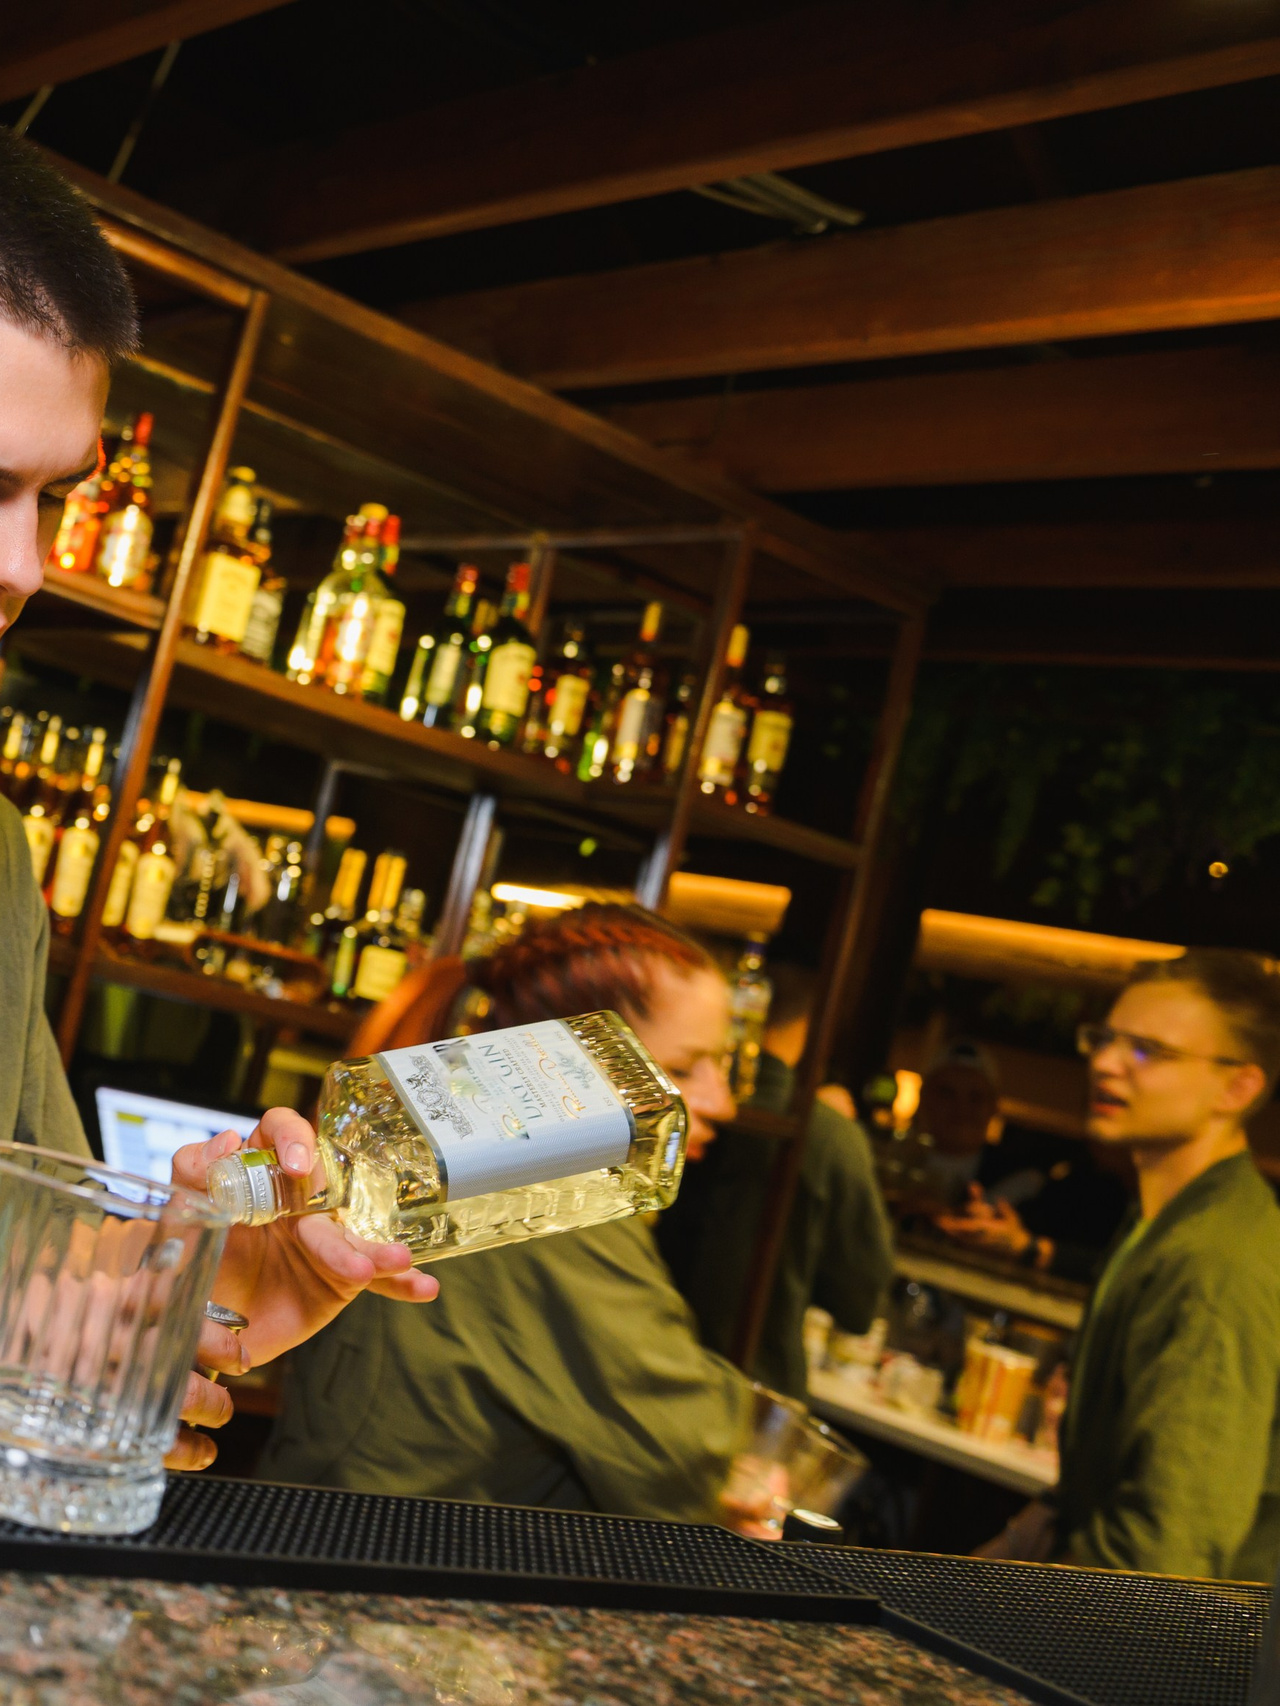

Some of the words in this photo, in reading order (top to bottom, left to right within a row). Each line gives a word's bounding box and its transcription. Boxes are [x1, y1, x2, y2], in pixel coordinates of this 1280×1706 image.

[476, 1043, 515, 1078] GIN
[501, 1048, 525, 1074] CRAFTED
[520, 1075, 547, 1108] MASTERLY
[254, 1169, 266, 1210] QUALITY
